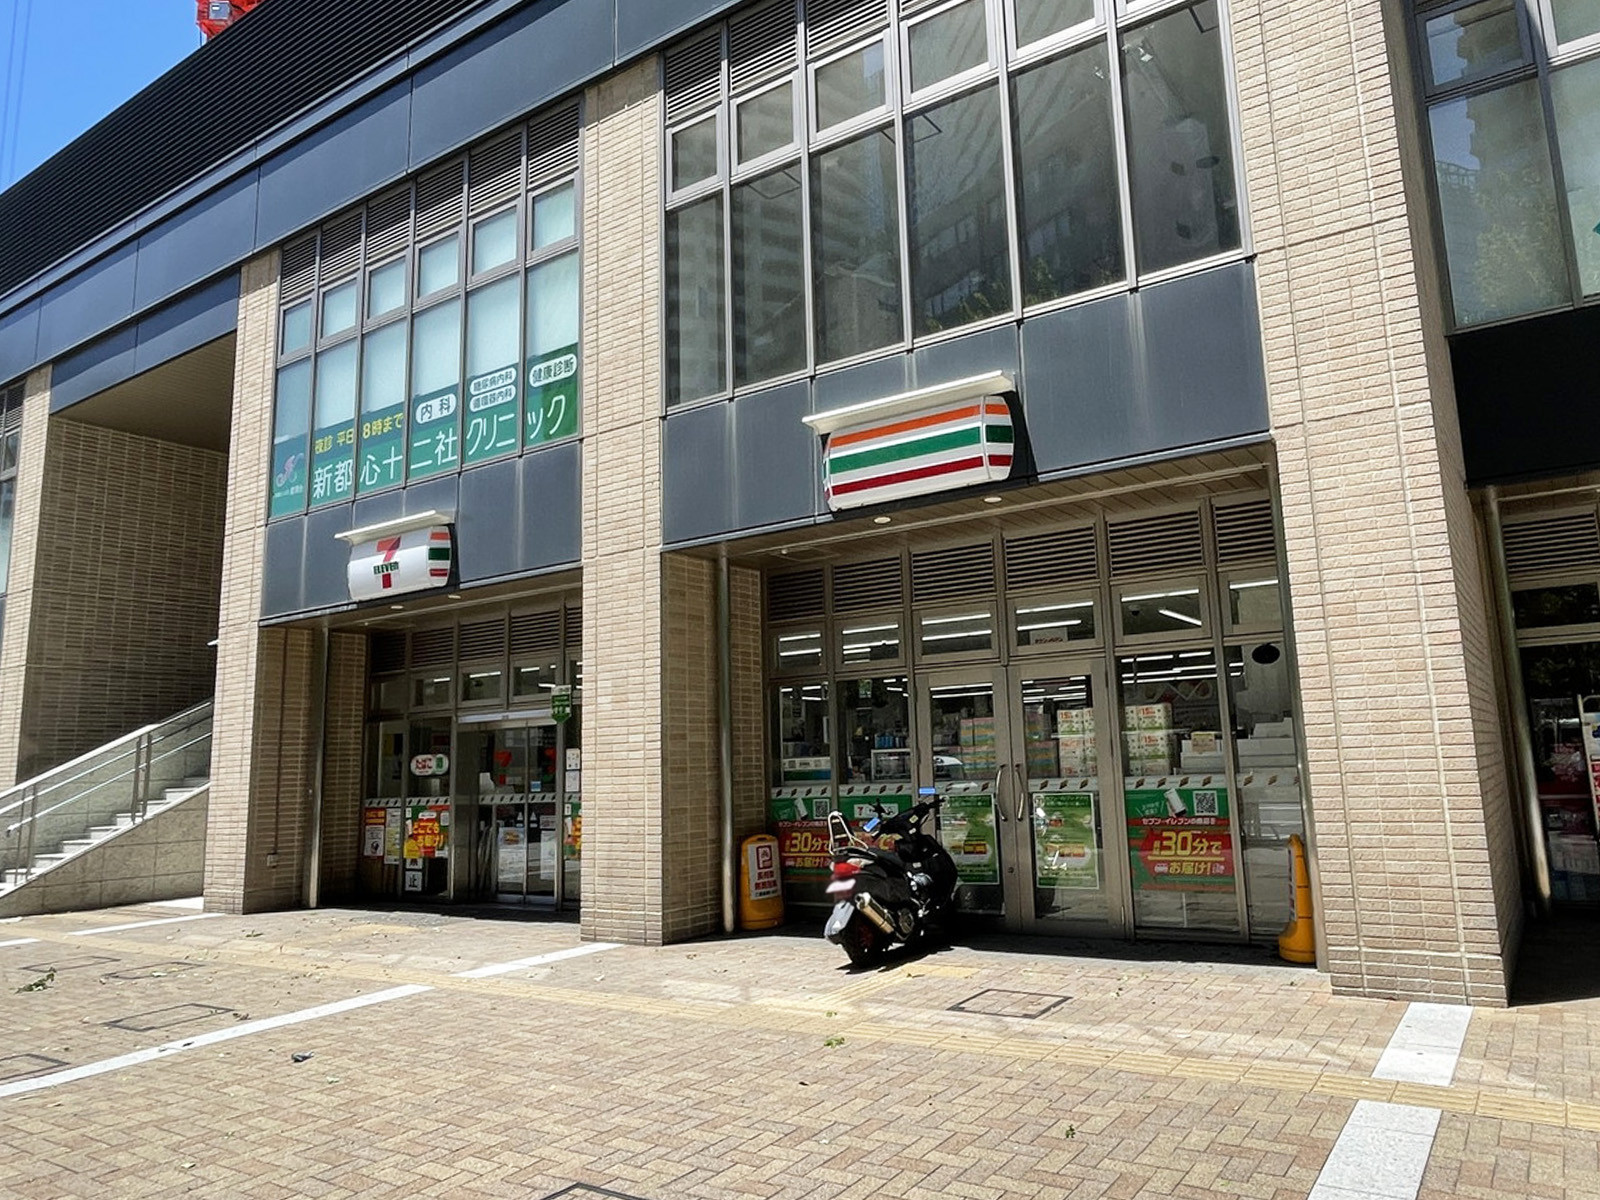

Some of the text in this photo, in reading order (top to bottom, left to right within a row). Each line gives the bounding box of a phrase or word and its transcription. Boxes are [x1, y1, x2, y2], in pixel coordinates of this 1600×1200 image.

[532, 357, 574, 384] 健康診断
[420, 397, 452, 421] 内科
[362, 412, 404, 439] 8時まで
[312, 394, 566, 499] 新都心十二社クリニック
